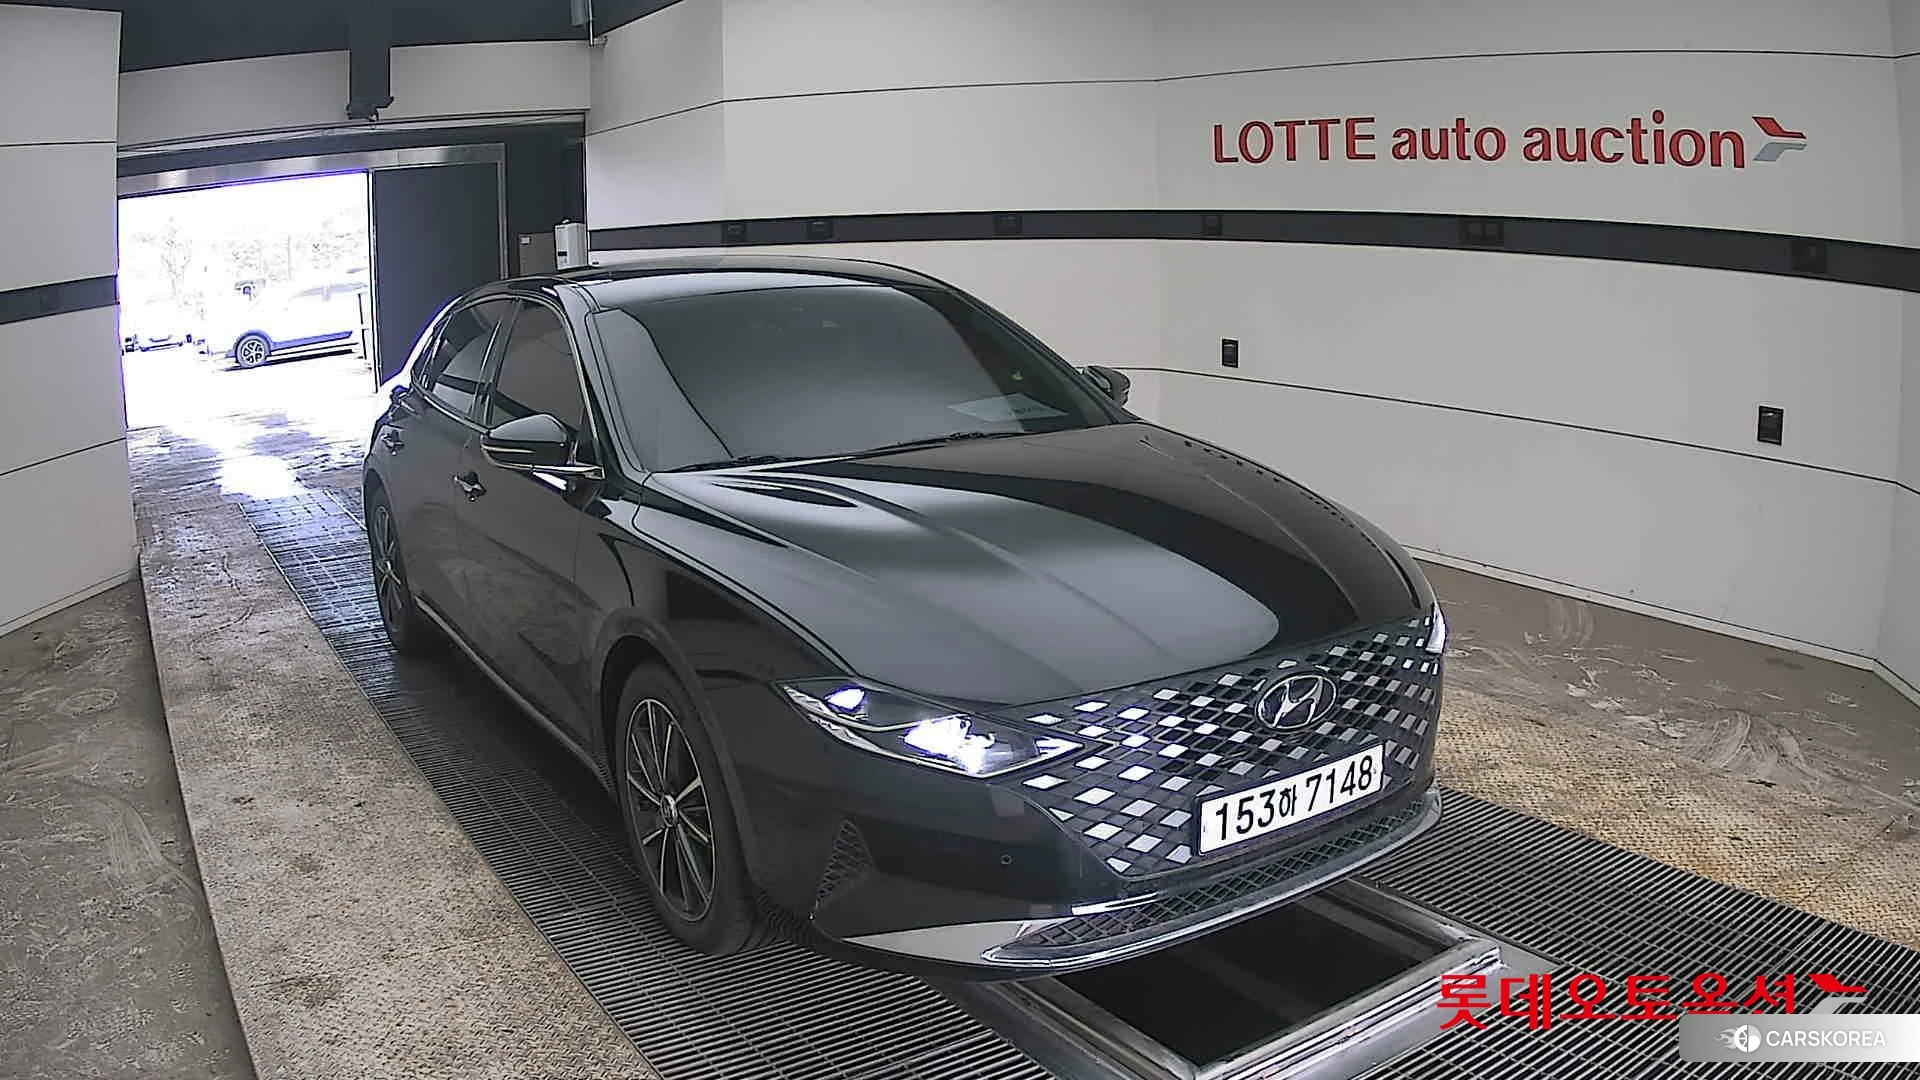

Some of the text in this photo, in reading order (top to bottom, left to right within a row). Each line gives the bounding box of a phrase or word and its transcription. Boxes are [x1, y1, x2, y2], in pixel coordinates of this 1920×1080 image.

[1212, 109, 1746, 169] LOTTE auto auction
[1215, 755, 1373, 841] 153하 7148
